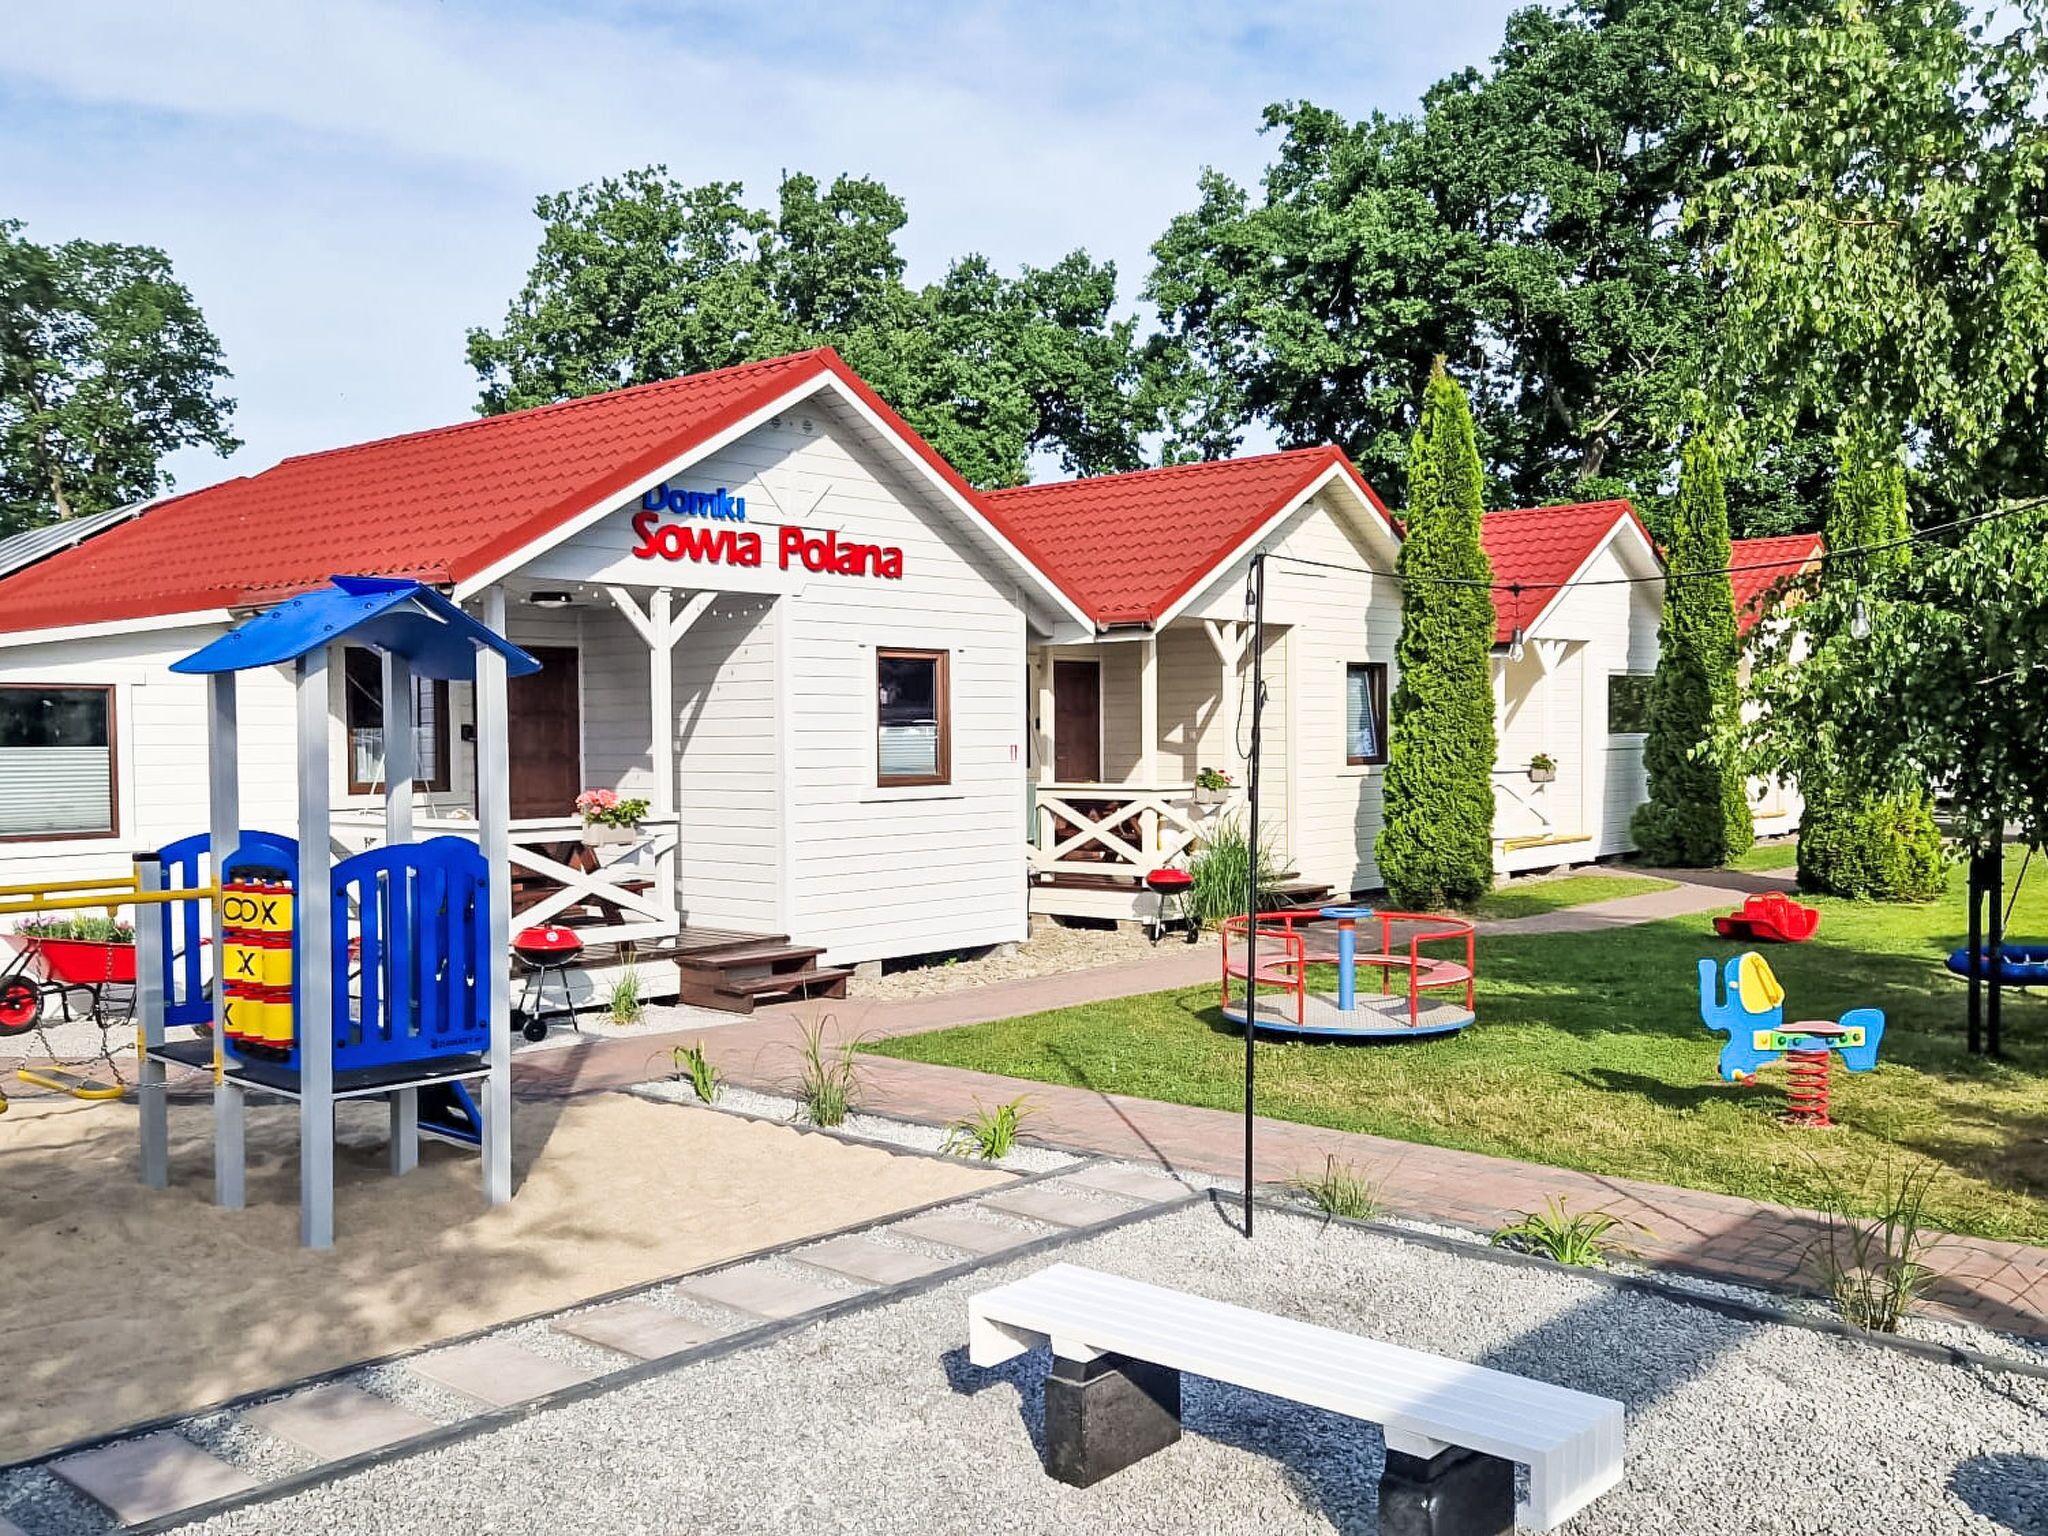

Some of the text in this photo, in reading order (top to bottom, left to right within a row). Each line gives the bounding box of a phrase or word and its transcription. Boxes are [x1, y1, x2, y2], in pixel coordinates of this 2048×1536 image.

[643, 482, 746, 522] Domki
[632, 511, 903, 580] Sowia Polana
